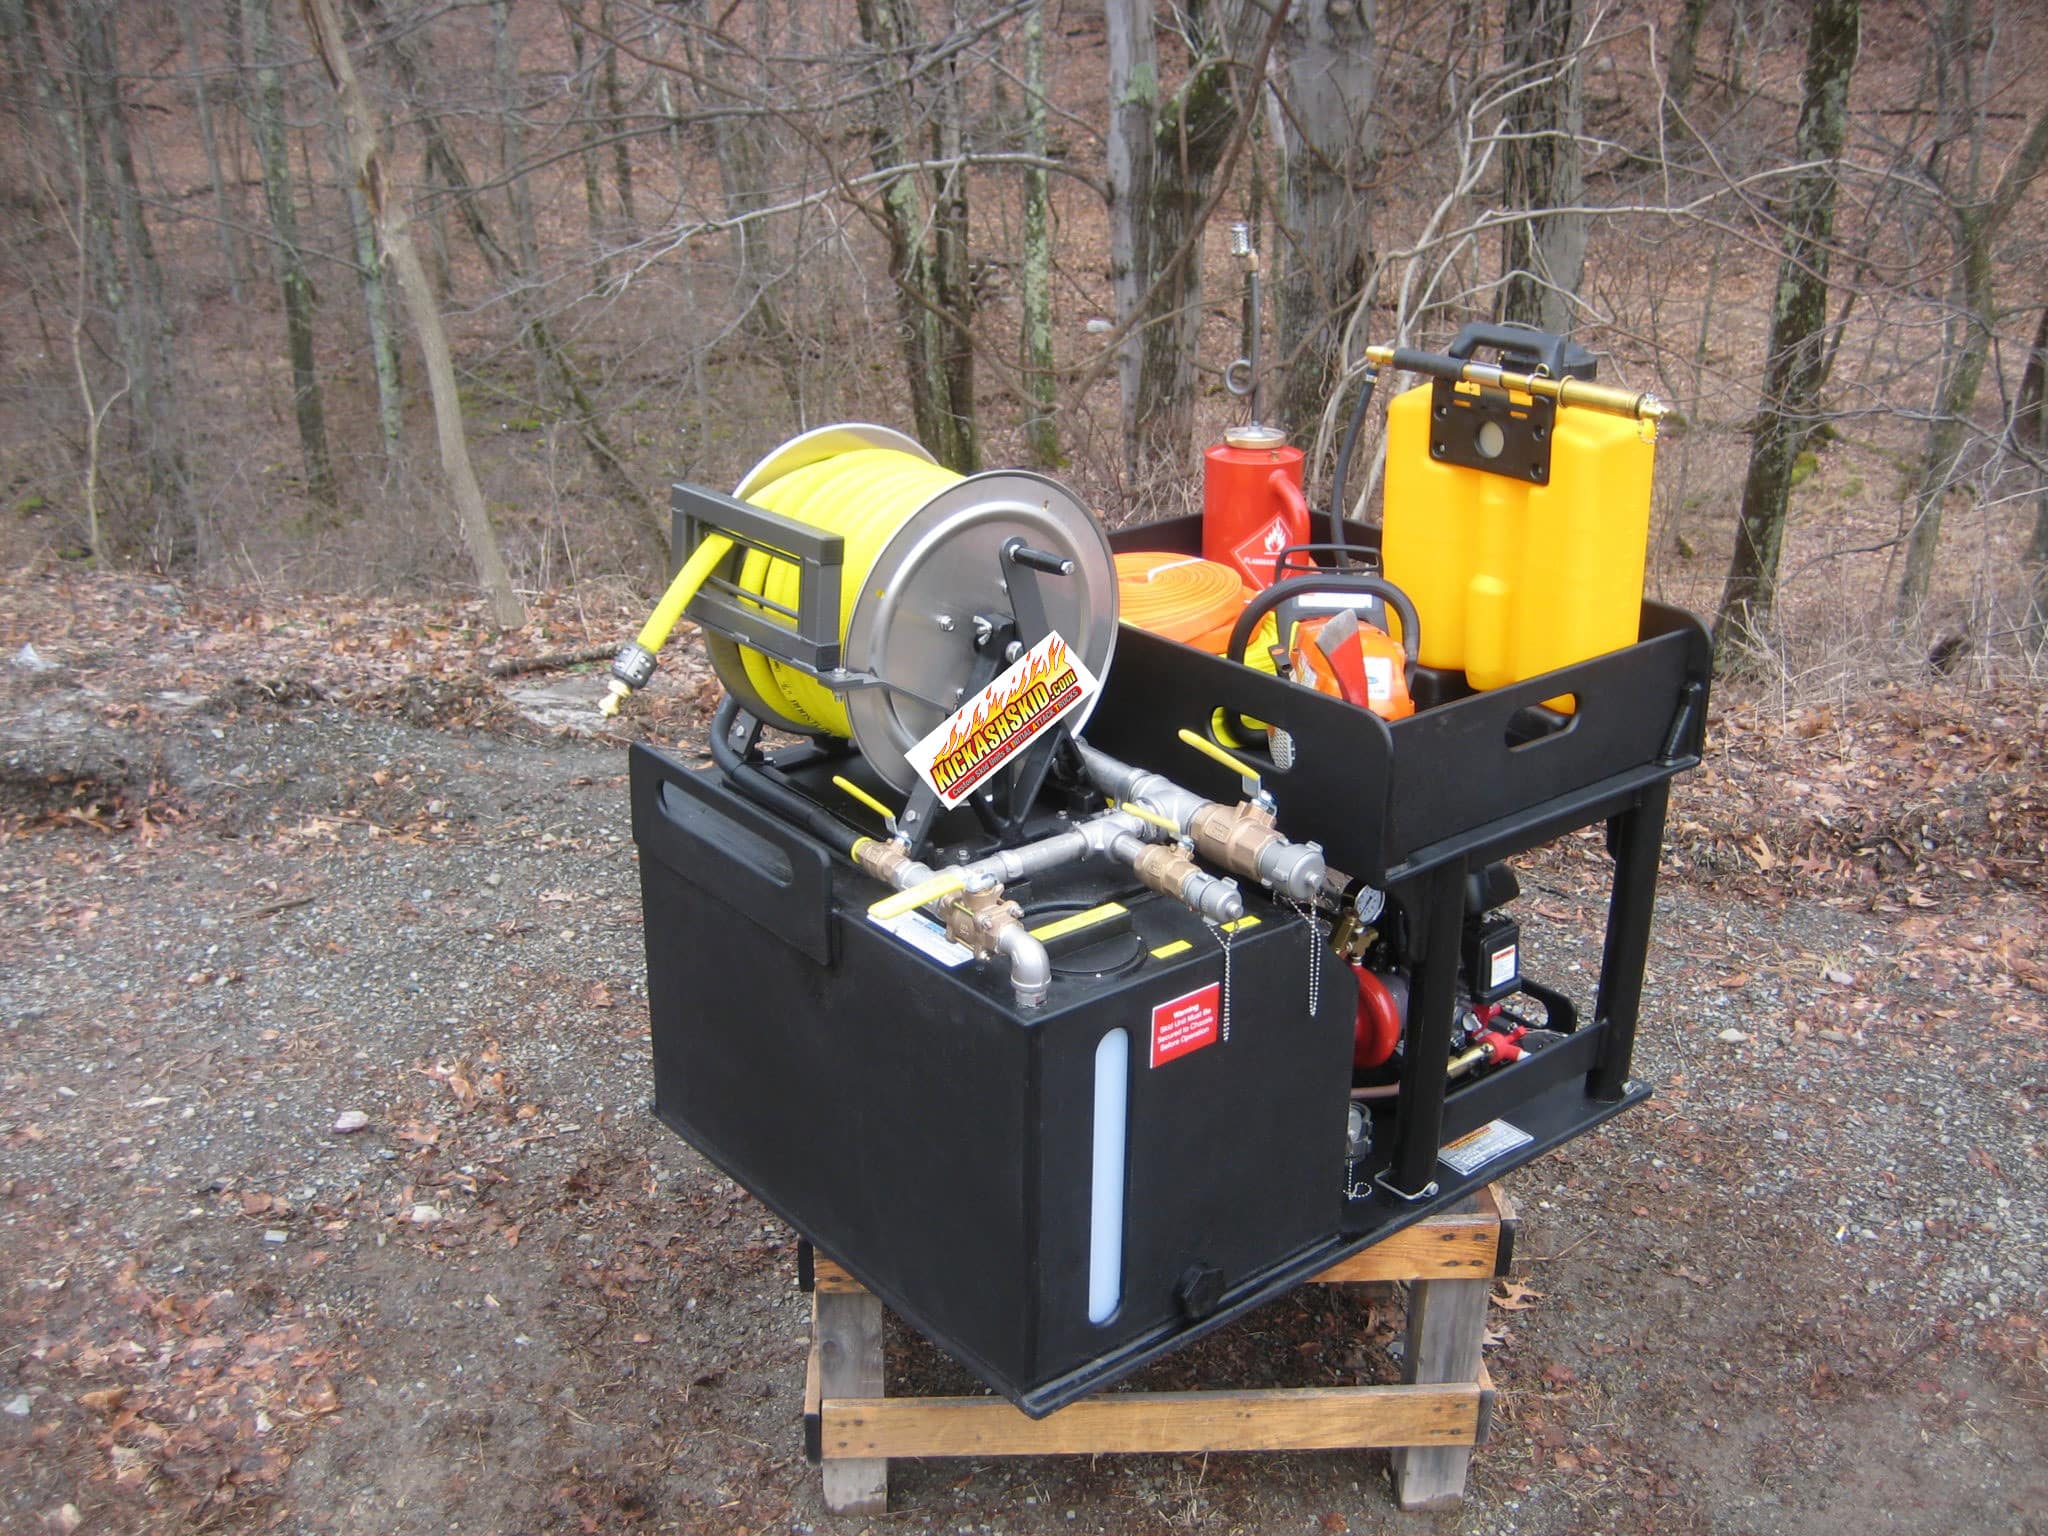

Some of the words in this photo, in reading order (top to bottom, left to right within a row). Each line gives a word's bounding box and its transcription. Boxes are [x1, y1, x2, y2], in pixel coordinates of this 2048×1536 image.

[1160, 1022, 1174, 1034] Skid
[1174, 1017, 1187, 1027] Unit
[1187, 1010, 1202, 1022] Must
[1202, 1008, 1212, 1016] Be
[1173, 1004, 1200, 1019] Warning
[1158, 1028, 1183, 1044] Secured
[1190, 1016, 1214, 1030] Chassis
[1160, 1039, 1180, 1052] Before
[1180, 1026, 1210, 1043] Operation
